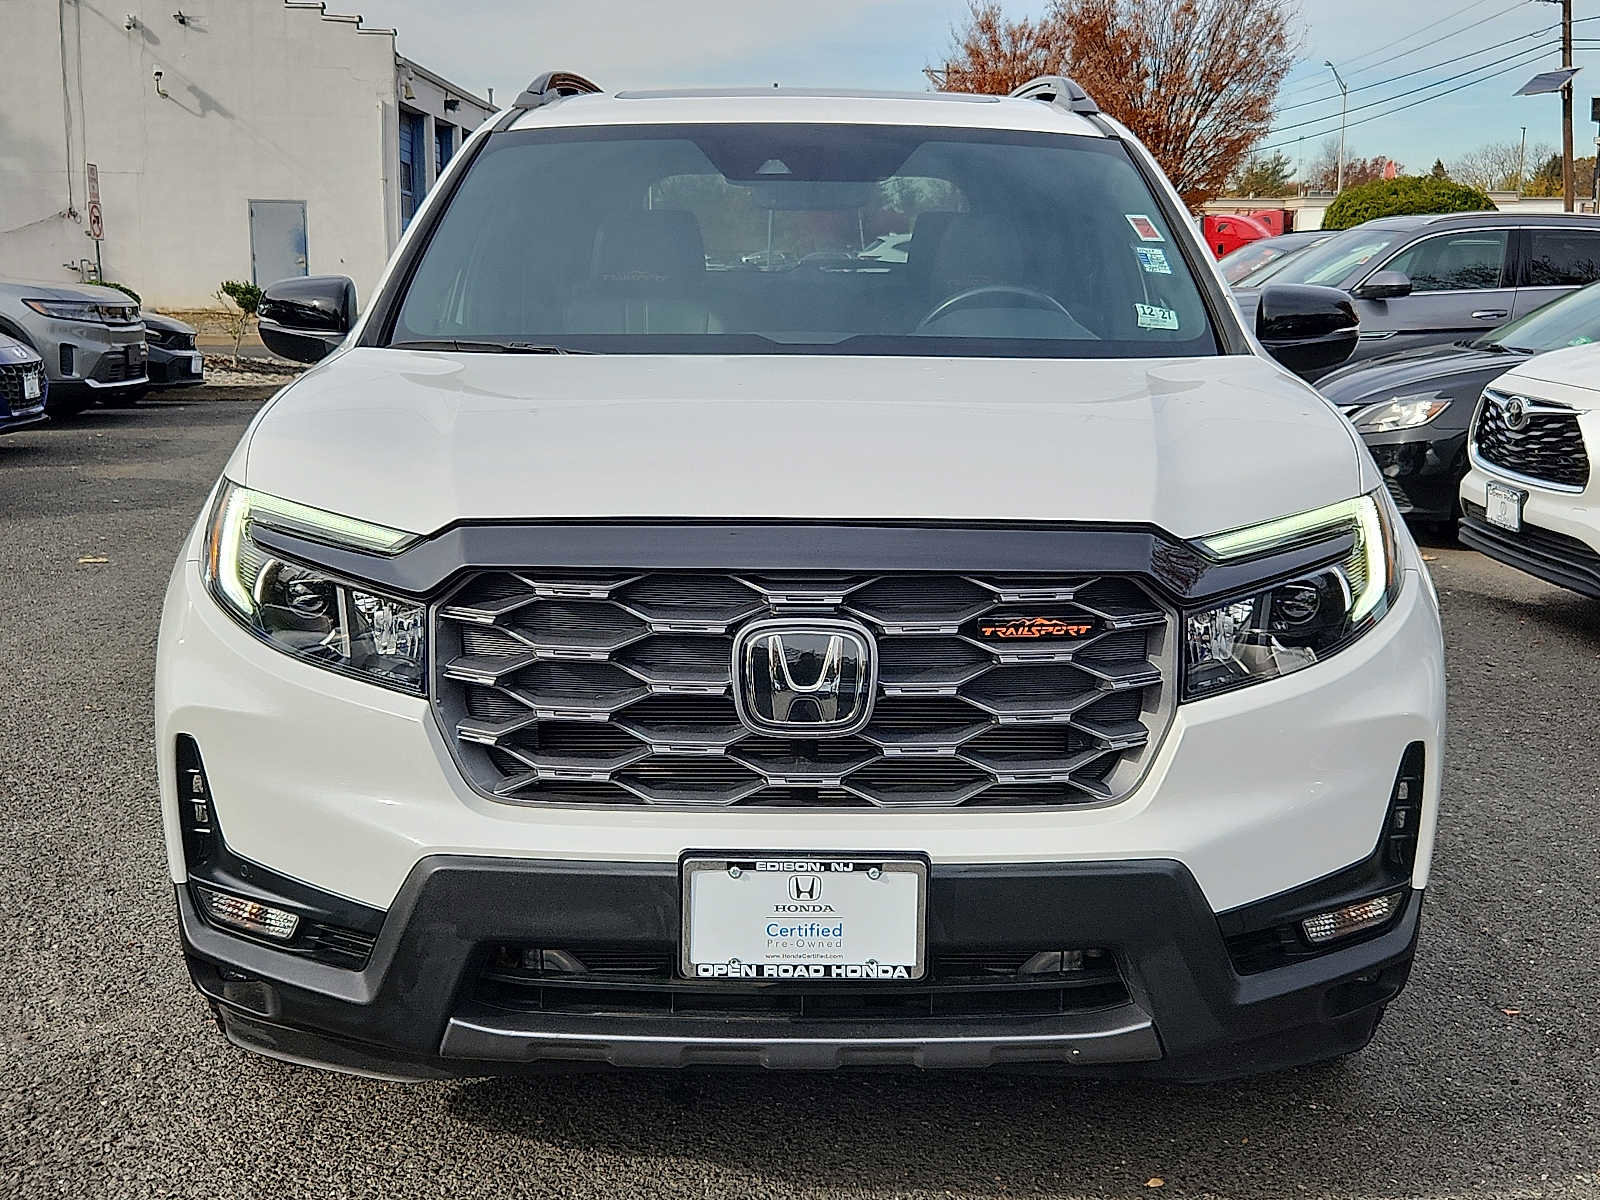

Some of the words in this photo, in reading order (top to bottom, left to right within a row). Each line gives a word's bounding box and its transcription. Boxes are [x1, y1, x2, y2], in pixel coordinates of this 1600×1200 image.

[1140, 305, 1155, 317] 12
[981, 625, 1092, 637] TRAILSPORT
[755, 861, 826, 872] EDISON,
[830, 862, 854, 872] NJ
[773, 904, 835, 913] HONDA
[766, 923, 843, 938] Certified
[767, 939, 843, 949] Pre-Owned
[697, 964, 757, 977] OPEN
[763, 965, 825, 978] ROAD
[831, 965, 909, 978] HONDA
